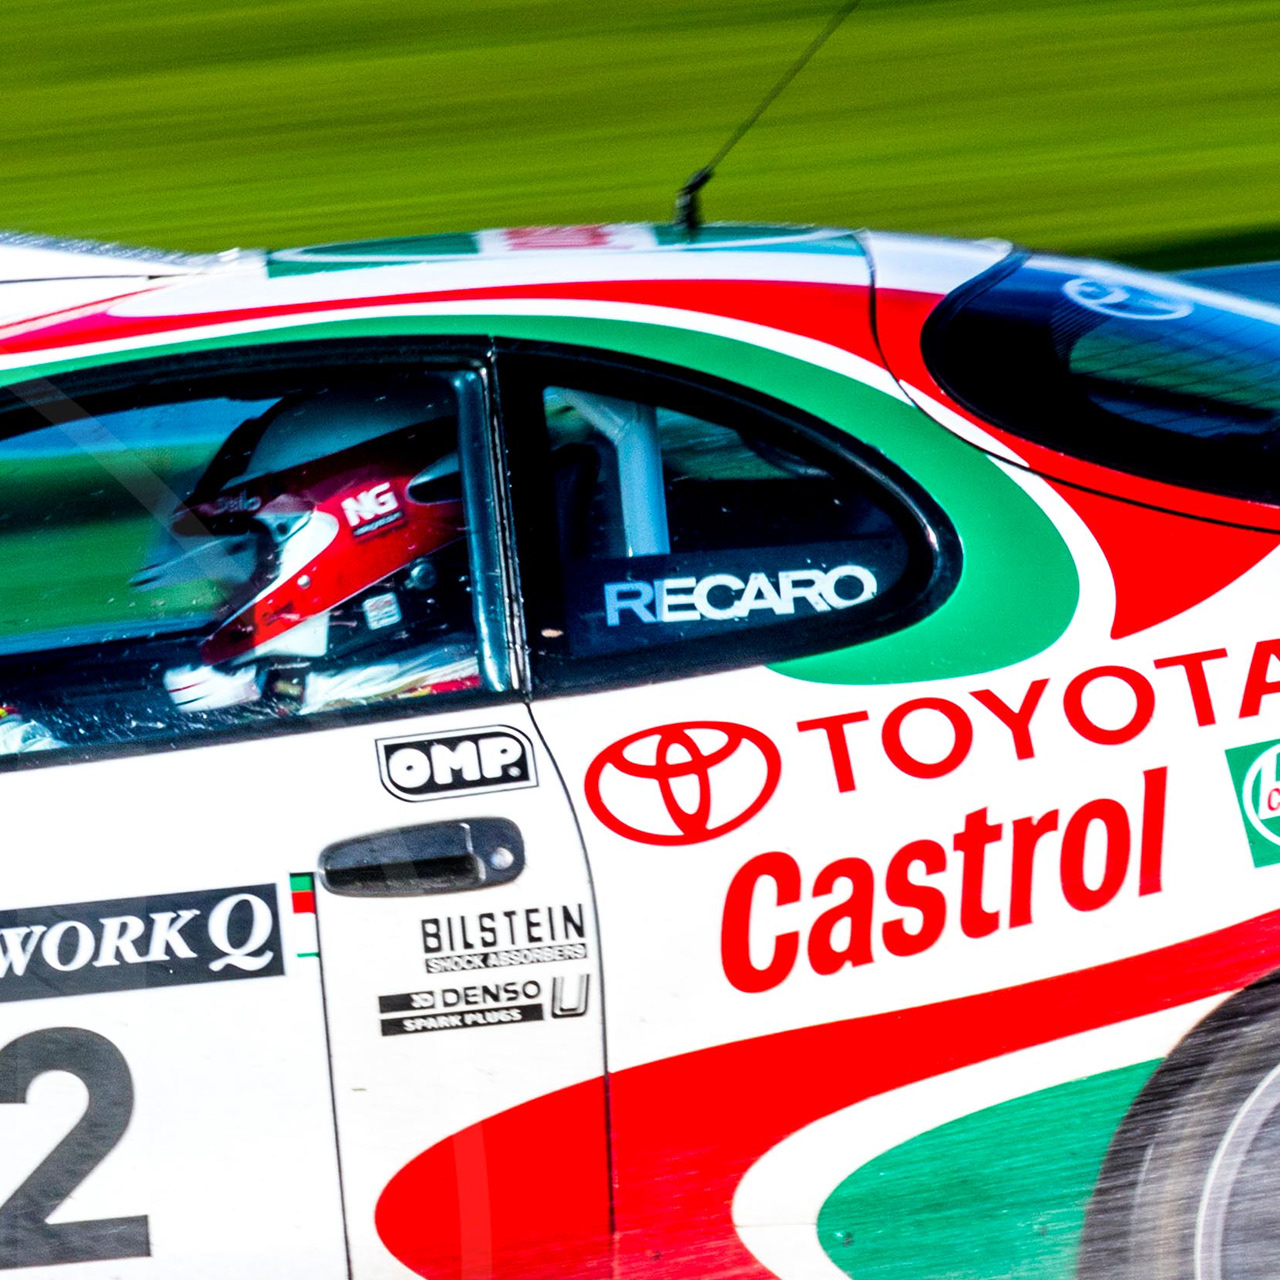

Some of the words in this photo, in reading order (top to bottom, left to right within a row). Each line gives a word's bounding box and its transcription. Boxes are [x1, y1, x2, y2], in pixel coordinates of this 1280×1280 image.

[341, 482, 398, 526] NG
[604, 565, 877, 626] RECARO
[719, 766, 1168, 993] Castrol
[206, 891, 276, 975] Q
[421, 903, 586, 954] BILSTEIN
[442, 980, 541, 1008] DENSO
[402, 1013, 462, 1032] SPARK
[462, 1008, 522, 1027] PLUGS
